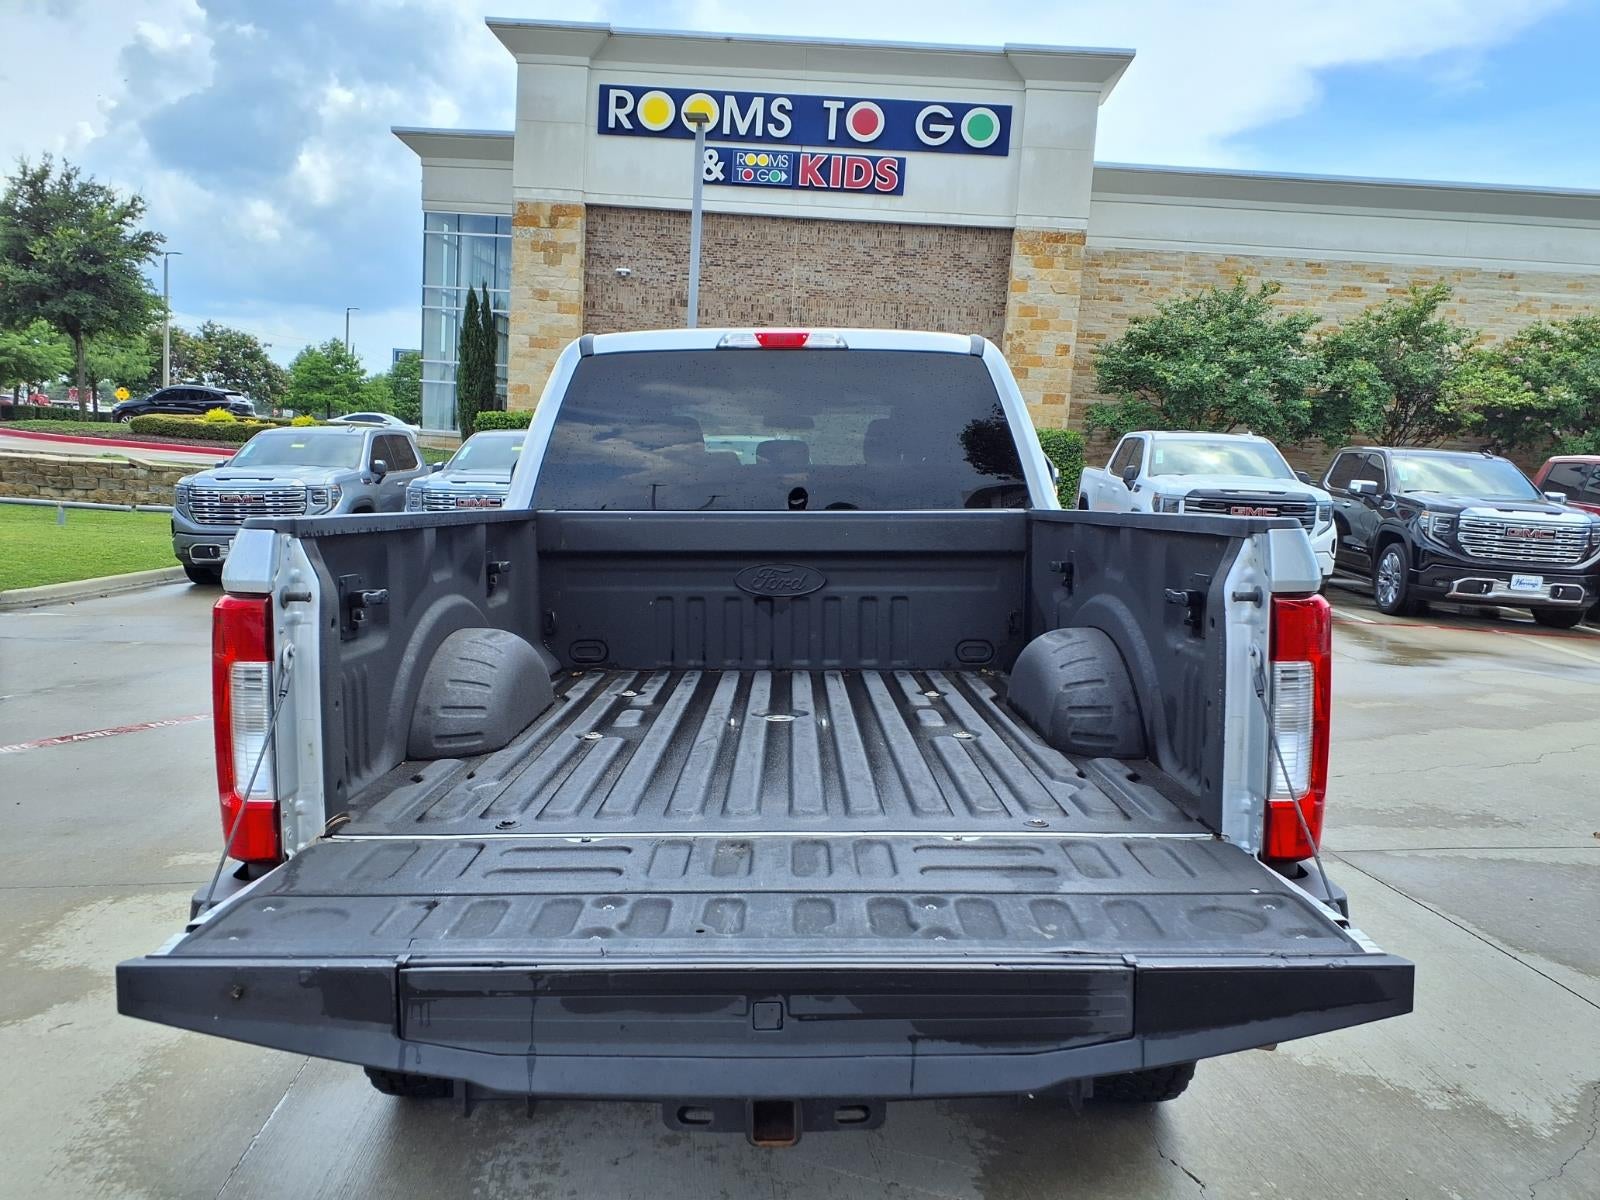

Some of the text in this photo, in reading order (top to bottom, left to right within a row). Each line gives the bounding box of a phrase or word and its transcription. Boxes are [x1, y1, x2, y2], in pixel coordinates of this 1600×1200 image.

[607, 89, 1001, 149] ROOMS TO GO
[703, 149, 725, 182] &
[736, 152, 789, 168] ROOMS
[737, 168, 783, 183] TO GO
[799, 153, 899, 192] KIDS
[221, 494, 264, 504] GMC
[457, 497, 502, 507] GMC
[1230, 506, 1278, 517] GMC
[1506, 527, 1555, 539] GMC
[752, 566, 807, 591] Ford
